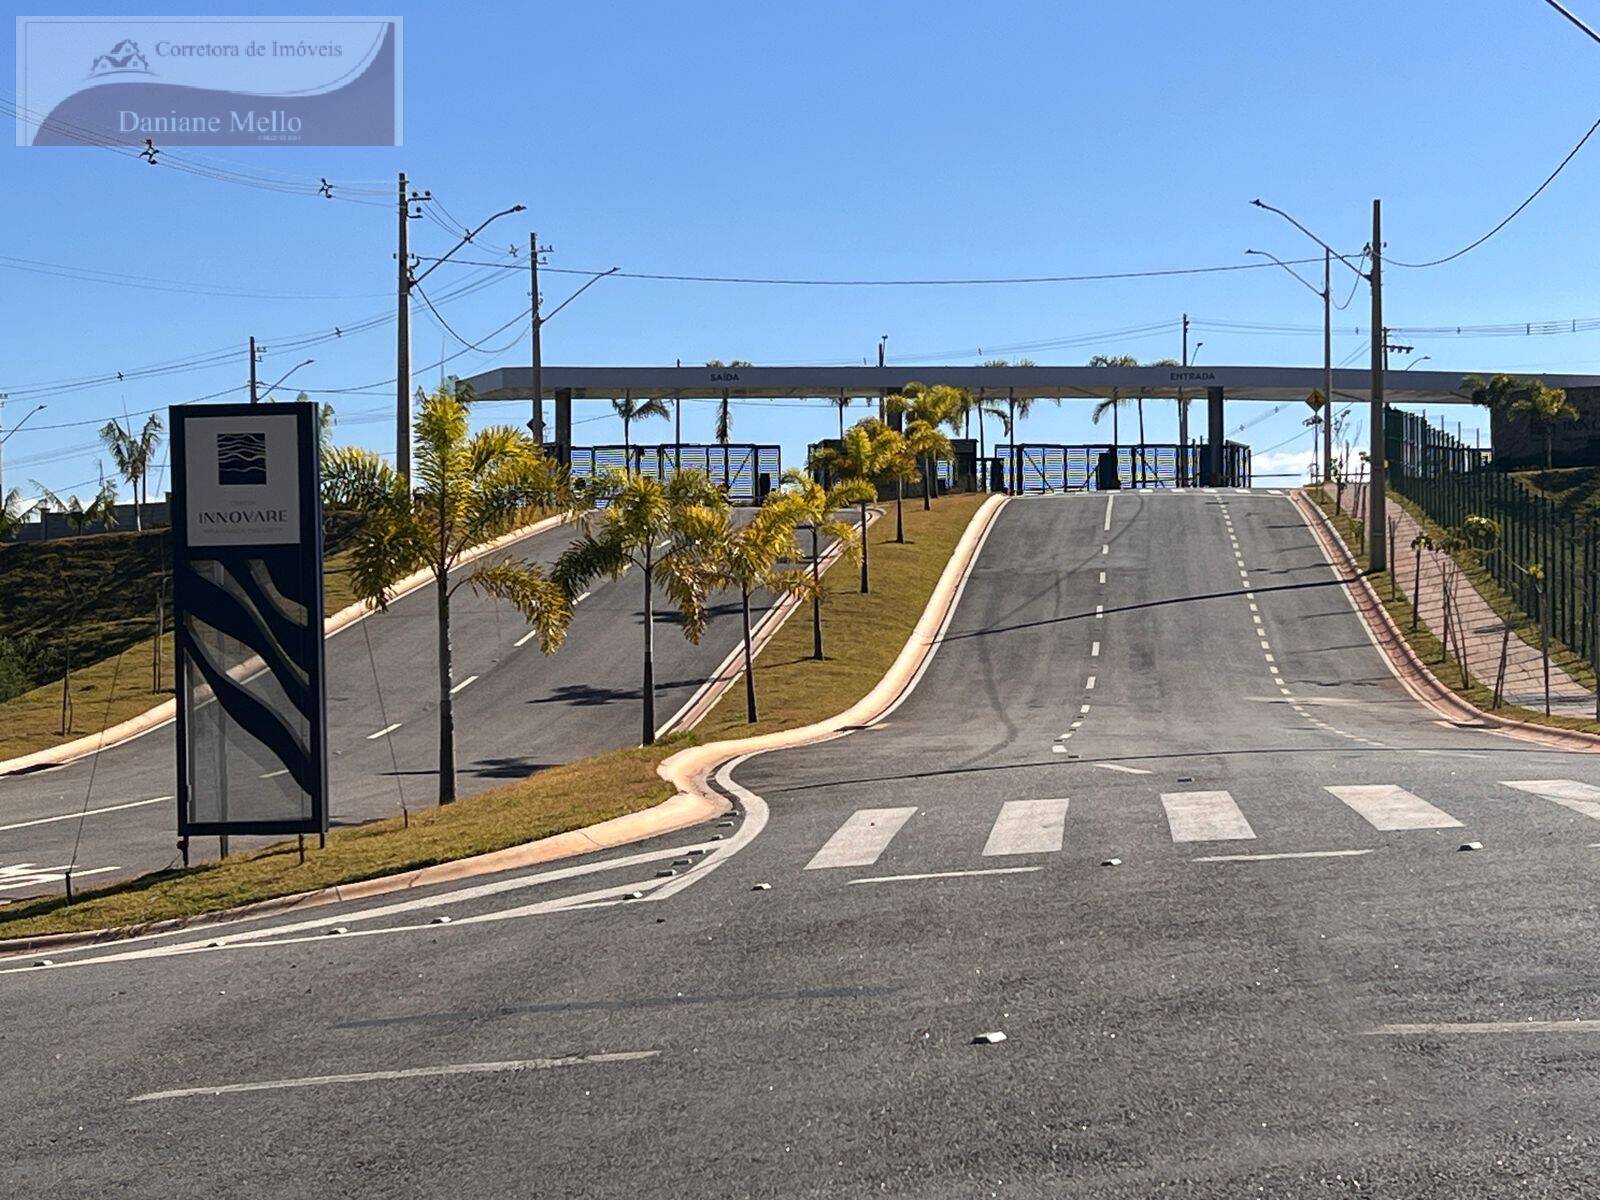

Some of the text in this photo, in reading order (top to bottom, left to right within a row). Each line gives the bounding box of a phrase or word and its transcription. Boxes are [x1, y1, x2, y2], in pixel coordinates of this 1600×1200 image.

[710, 371, 740, 381] SAÍDA
[1170, 372, 1215, 381] ENTRADA
[198, 509, 288, 524] INNOVARE
